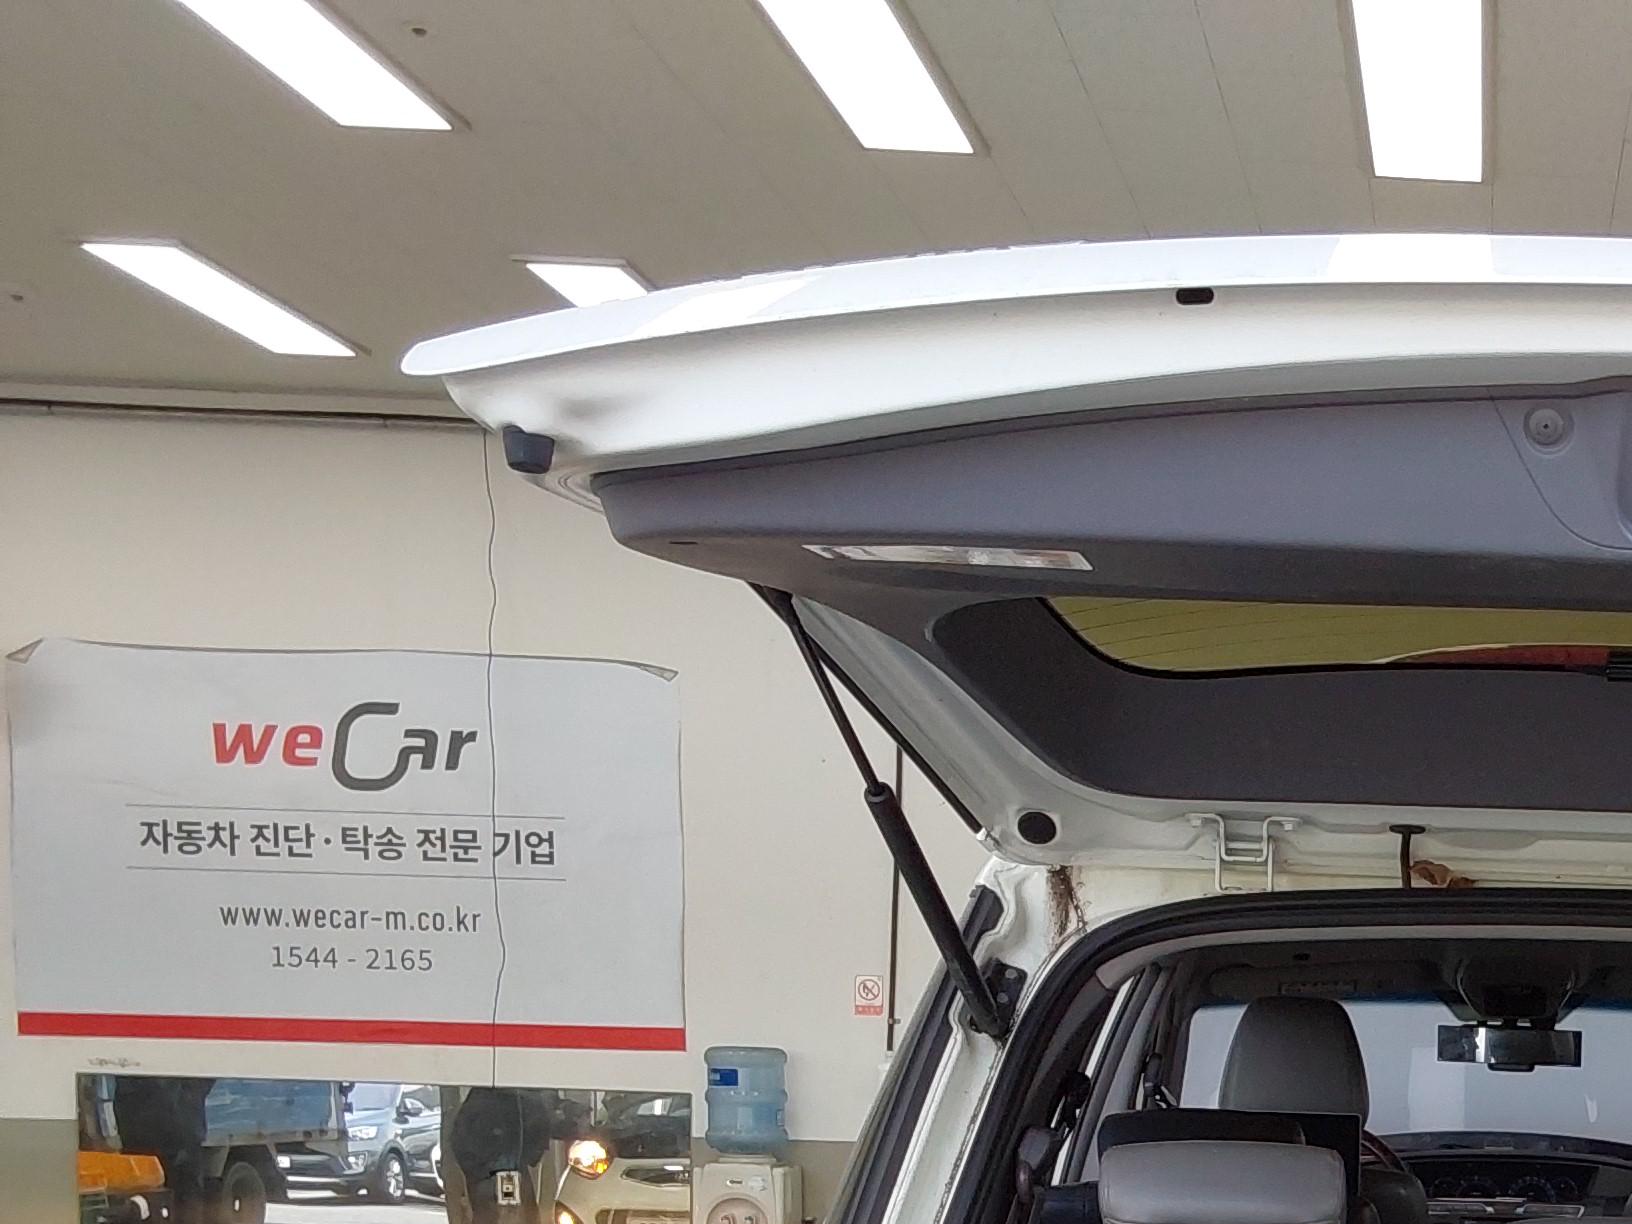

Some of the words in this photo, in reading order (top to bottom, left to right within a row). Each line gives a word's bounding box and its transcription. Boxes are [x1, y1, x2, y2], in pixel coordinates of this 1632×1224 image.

[212, 701, 478, 792] weCar
[139, 820, 241, 857] 자동차
[415, 827, 483, 864] 전문
[492, 829, 556, 866] 기업
[219, 905, 482, 933] www.wecar-m.co.kr
